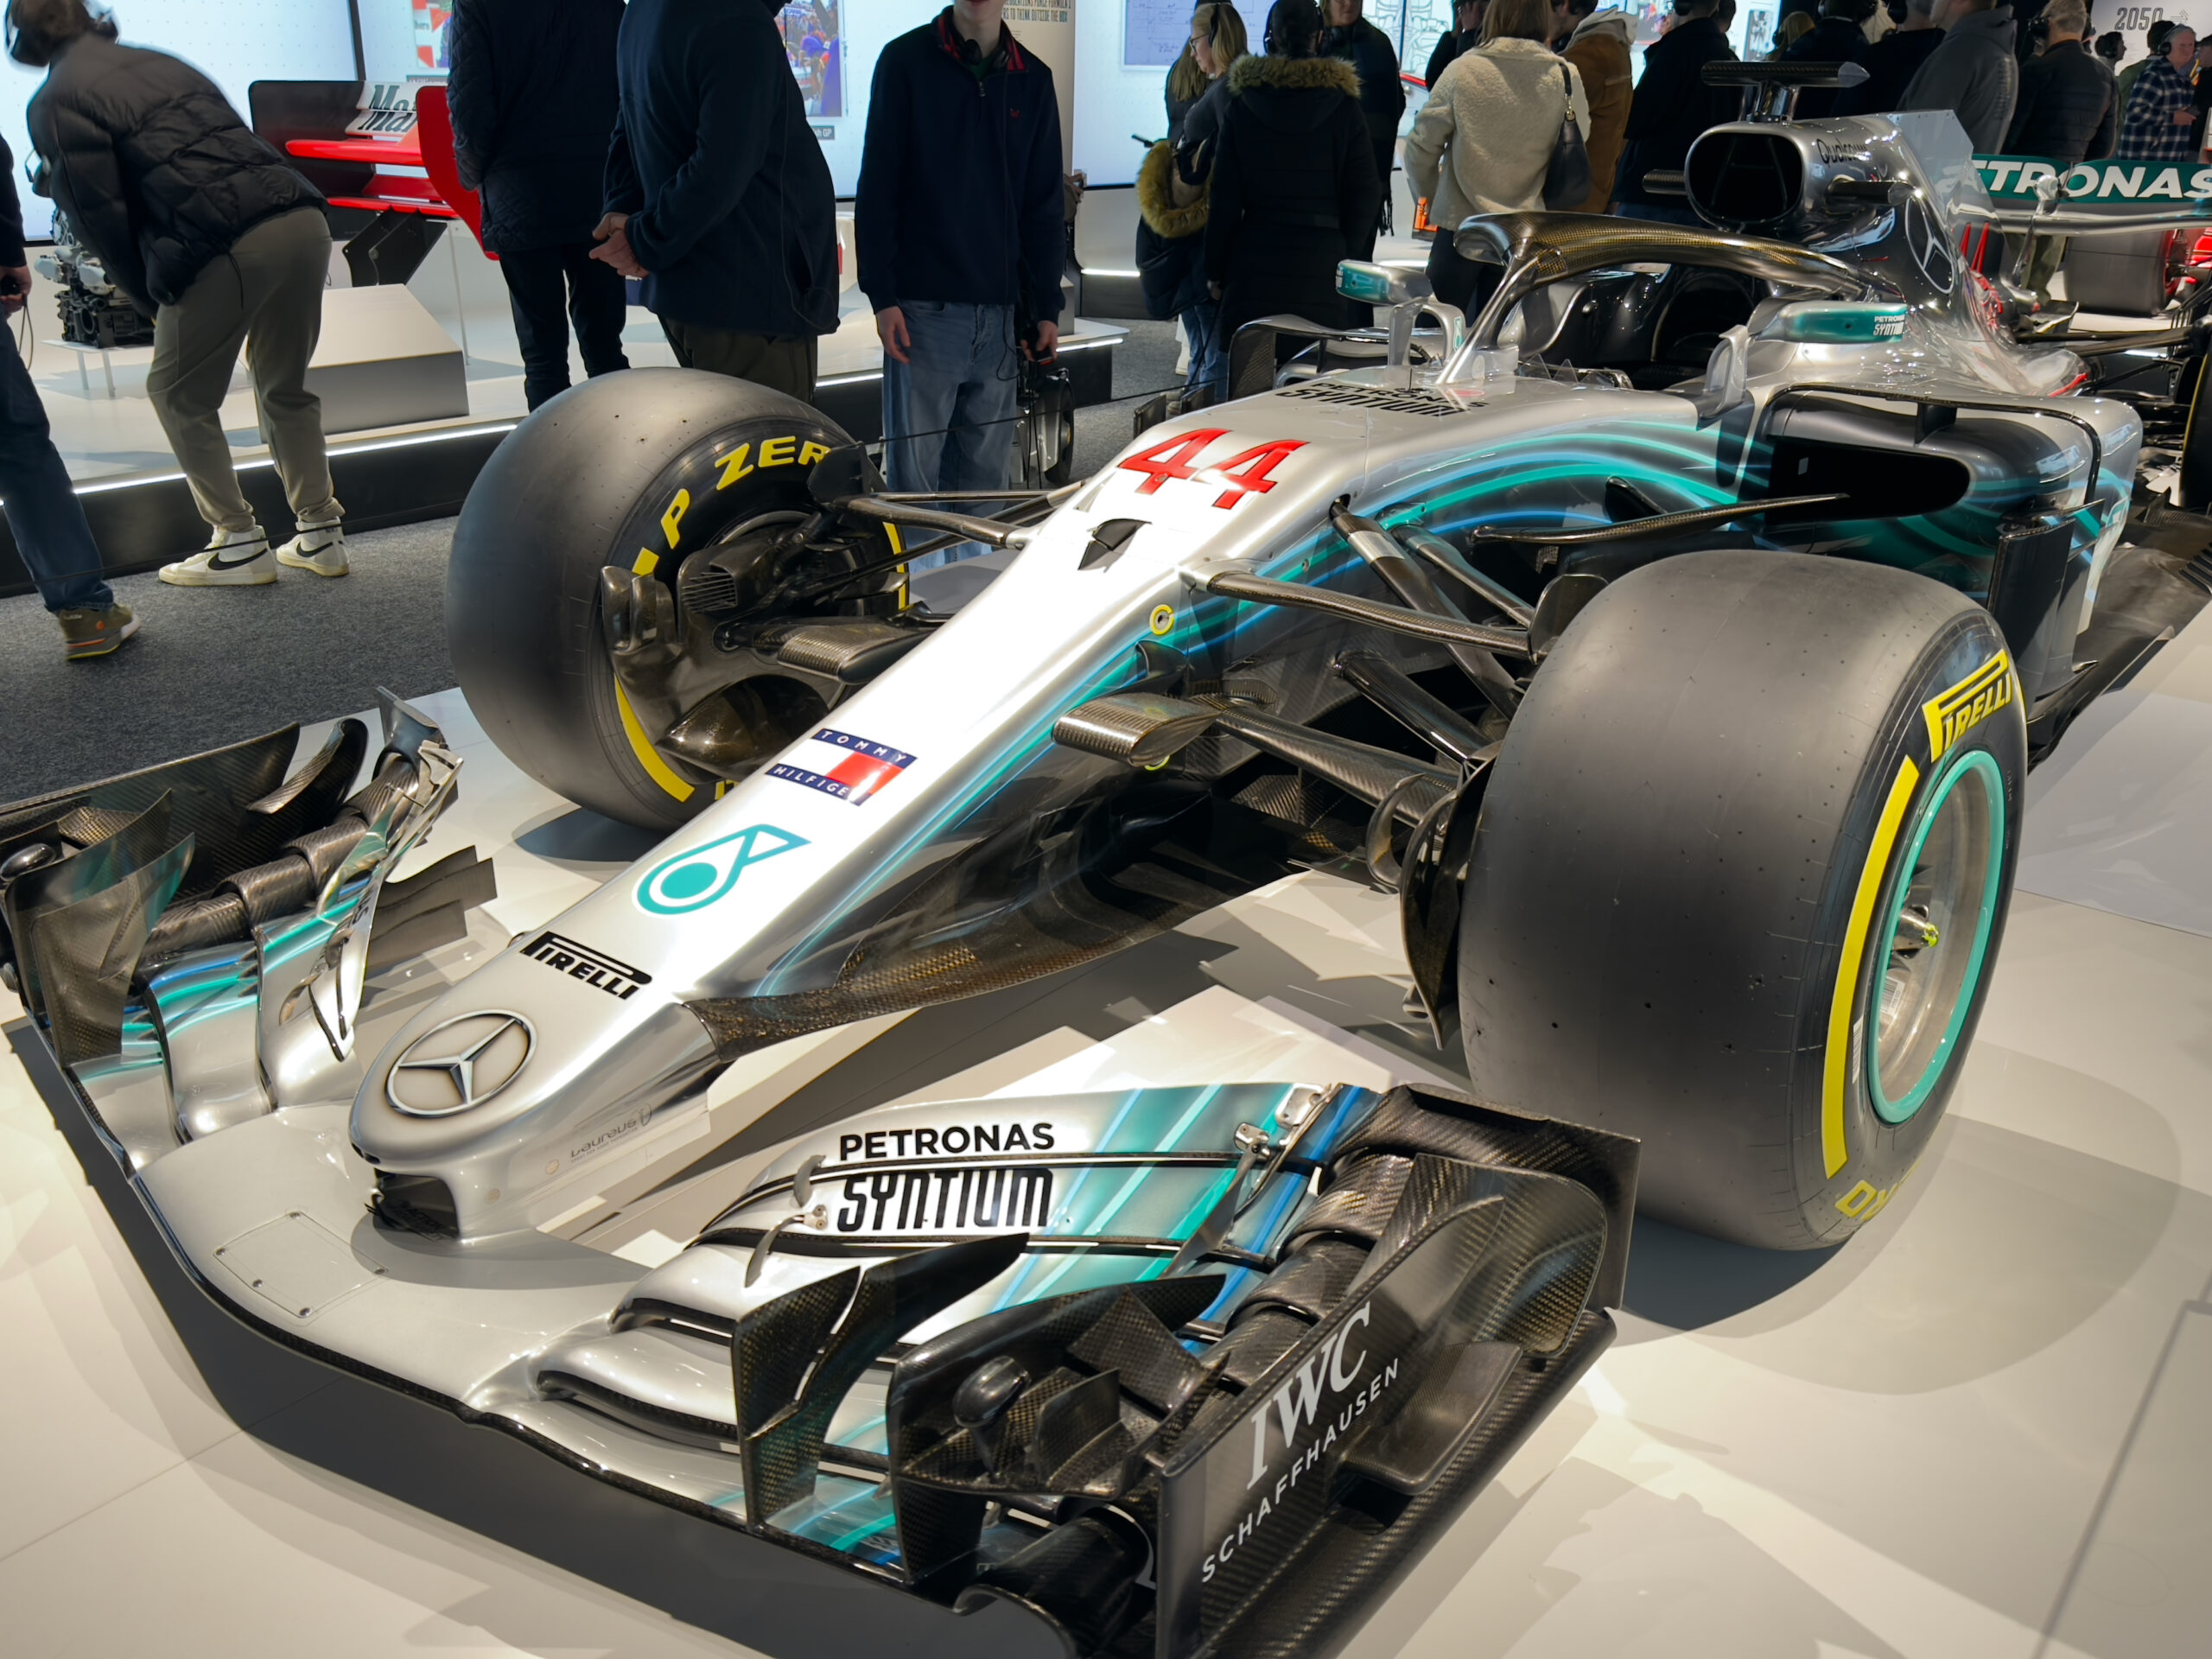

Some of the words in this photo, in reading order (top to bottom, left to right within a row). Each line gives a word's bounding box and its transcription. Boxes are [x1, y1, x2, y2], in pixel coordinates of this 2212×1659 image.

[2113, 7, 2164, 31] 2050
[1275, 389, 1471, 417] SYNTIUM
[660, 488, 690, 550] P
[714, 435, 831, 491] ZER
[1117, 428, 1312, 510] 44
[1922, 648, 2013, 764] PIRELLI
[821, 730, 907, 762] TOMMY
[773, 766, 851, 797] HILFIGE
[519, 931, 652, 1001] PIRELLI
[840, 1123, 1055, 1161] PETRONAS
[837, 1167, 1053, 1232] SYNTIUM
[1247, 1301, 1370, 1490] IWC
[1202, 1357, 1399, 1583] SCHAFFHAUSEN
